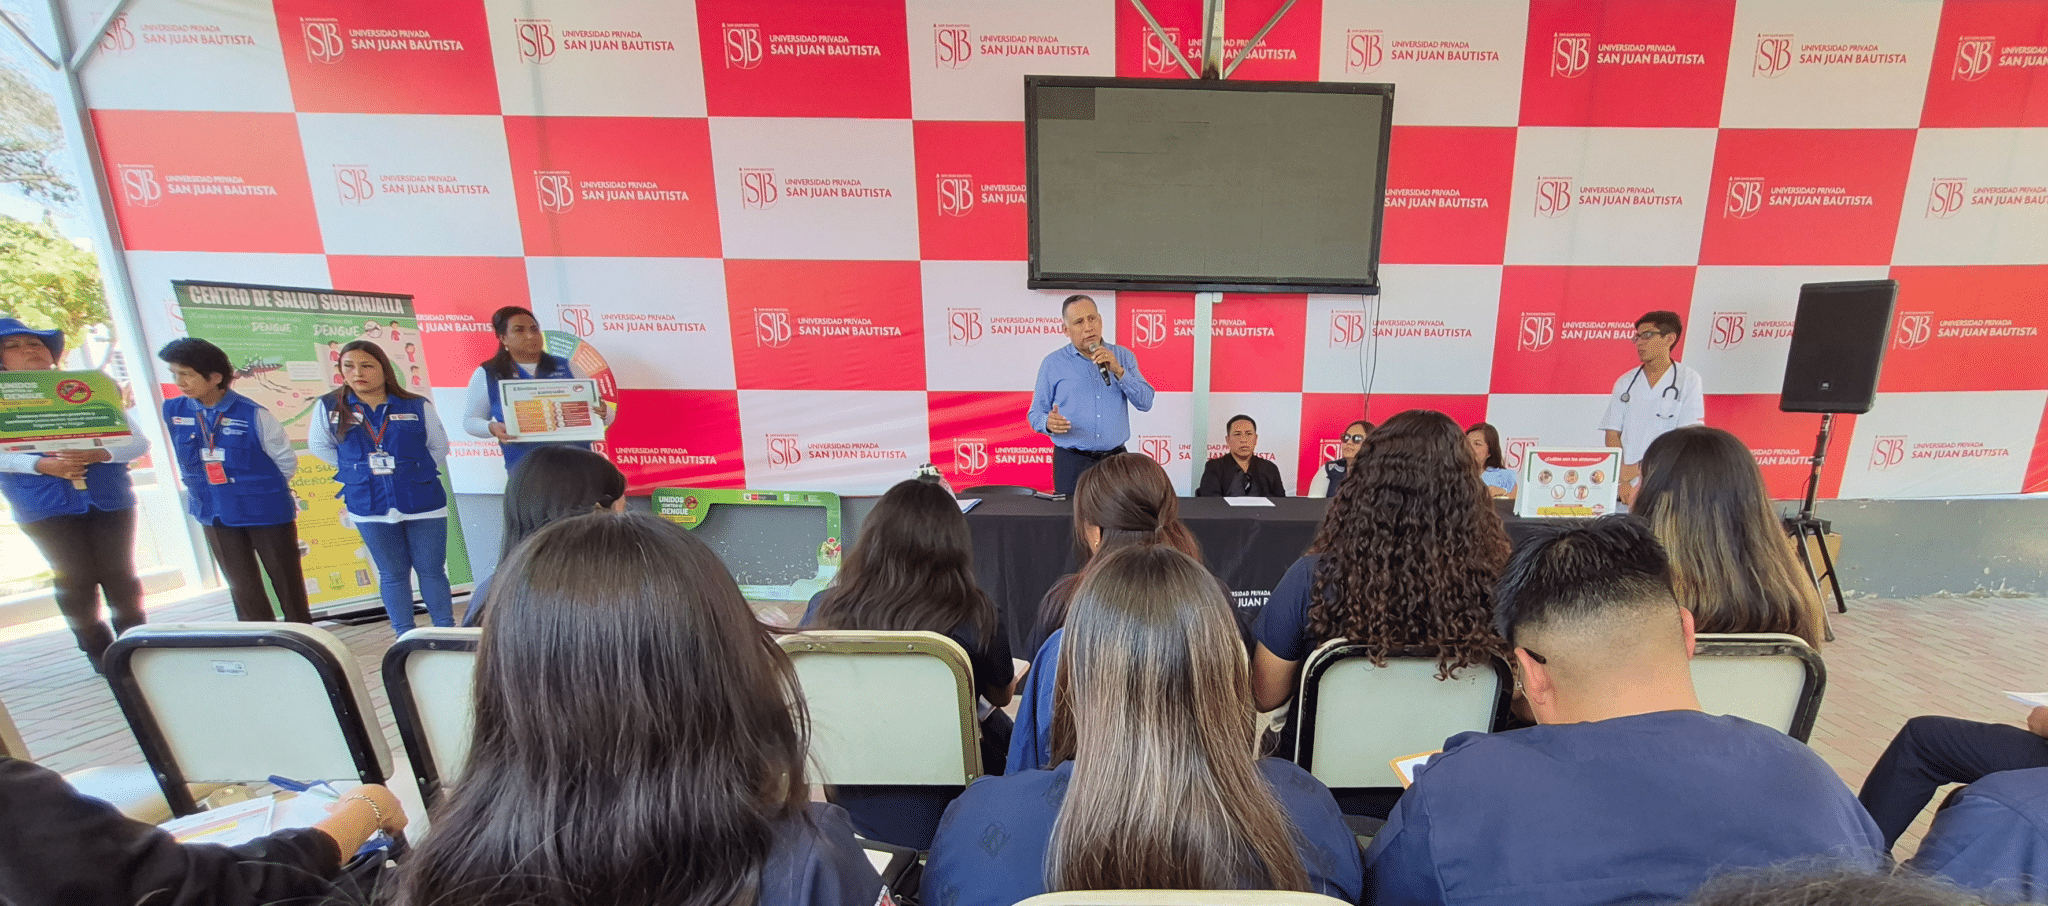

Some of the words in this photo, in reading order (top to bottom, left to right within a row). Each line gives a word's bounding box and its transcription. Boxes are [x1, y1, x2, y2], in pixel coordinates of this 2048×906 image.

[562, 30, 610, 38] UNIVERSIDAD
[769, 35, 816, 43] UNIVERSIDAD
[170, 35, 198, 45] JUAN
[200, 35, 255, 46] BAUTISTA
[351, 39, 375, 49] SAN
[378, 39, 408, 51] JUAN
[409, 40, 464, 51] BAUTISTA
[1029, 36, 1058, 44] PRIVADA
[564, 40, 587, 49] SAN
[590, 41, 619, 52] JUAN
[621, 41, 674, 51] BAUTISTA
[771, 44, 794, 54] SAN
[796, 45, 825, 56] JUAN
[828, 45, 881, 55] BAUTISTA
[981, 45, 1003, 54] SAN
[1006, 46, 1034, 57] JUAN
[1037, 46, 1089, 56] BAUTISTA
[1392, 50, 1413, 60] SAN
[1416, 51, 1445, 61] JUAN
[1447, 51, 1499, 61] BAUTISTA
[1597, 54, 1620, 63] SAN
[1621, 54, 1651, 64] JUAN
[1653, 54, 1705, 65] BAUTISTA
[1800, 54, 1822, 63] SAN
[1823, 54, 1853, 64] JUAN
[1855, 54, 1906, 63] BAUTISTA
[1999, 56, 2021, 66] SAN
[168, 184, 191, 194] SAN
[193, 185, 221, 196] JUAN
[224, 185, 276, 196] BAUTISTA
[382, 184, 405, 193] SAN
[407, 185, 435, 195] JUAN
[438, 185, 490, 195] BAUTISTA
[785, 188, 808, 197] SAN
[811, 188, 839, 199] JUAN
[841, 188, 892, 198] BAUTISTA
[581, 190, 604, 200] SAN
[607, 190, 635, 201] JUAN
[637, 191, 689, 201] BAUTISTA
[982, 194, 1003, 203] SAN
[1006, 194, 1026, 205] JUA
[1579, 196, 1601, 204] SAN
[1602, 196, 1630, 205] JUAN
[1633, 196, 1683, 206] BAUTISTA
[1770, 196, 1792, 206] SAN
[1793, 196, 1821, 206] JUAN
[1823, 196, 1872, 206] BAUTISTA
[1971, 196, 1993, 204] SAN
[1994, 196, 2022, 206] JUAN
[1384, 198, 1406, 207] SAN
[1408, 198, 1436, 209] JUAN
[1439, 198, 1488, 208] BAUTISTA
[189, 285, 250, 306] CENTRO
[252, 289, 273, 307] DE
[273, 291, 319, 310] SALUD
[321, 295, 405, 314] SUBTANJALLA
[252, 322, 292, 333] DENGUE
[313, 324, 361, 337] DENGUE
[426, 323, 453, 333] JUAN
[456, 323, 493, 332] BAUTIS
[603, 322, 624, 330] SAN
[627, 323, 654, 333] JUAN
[656, 323, 706, 332] BAUTISTA
[799, 326, 821, 335] SAN
[823, 327, 850, 337] JUAN
[852, 327, 901, 336] BAUTISTA
[991, 326, 1012, 334] SAN
[1014, 326, 1040, 335] JUAN
[1226, 327, 1274, 337] BAUTISTA
[1937, 328, 1959, 337] SAN
[1960, 328, 1987, 338] JUAN
[1988, 327, 2037, 337] BAUTISTA
[1372, 328, 1393, 337] SAN
[1395, 329, 1422, 339] JUAN
[1424, 329, 1472, 338] BAUTISTA
[1561, 330, 1582, 339] SAN
[1584, 330, 1611, 340] JUAN
[808, 450, 829, 459] SAN
[831, 450, 857, 460] JUAN
[860, 451, 907, 459] BAUTISTA
[995, 455, 1016, 463] SAN
[1018, 455, 1044, 465] JUAN
[1911, 450, 1932, 459] SAN
[1933, 450, 1960, 460] JUAN
[1961, 449, 2009, 457] BAUTISTA
[617, 455, 638, 464] SAN
[640, 456, 667, 466] JUAN
[669, 456, 717, 465] BAUTISTA
[1238, 597, 1261, 608] JUAN
